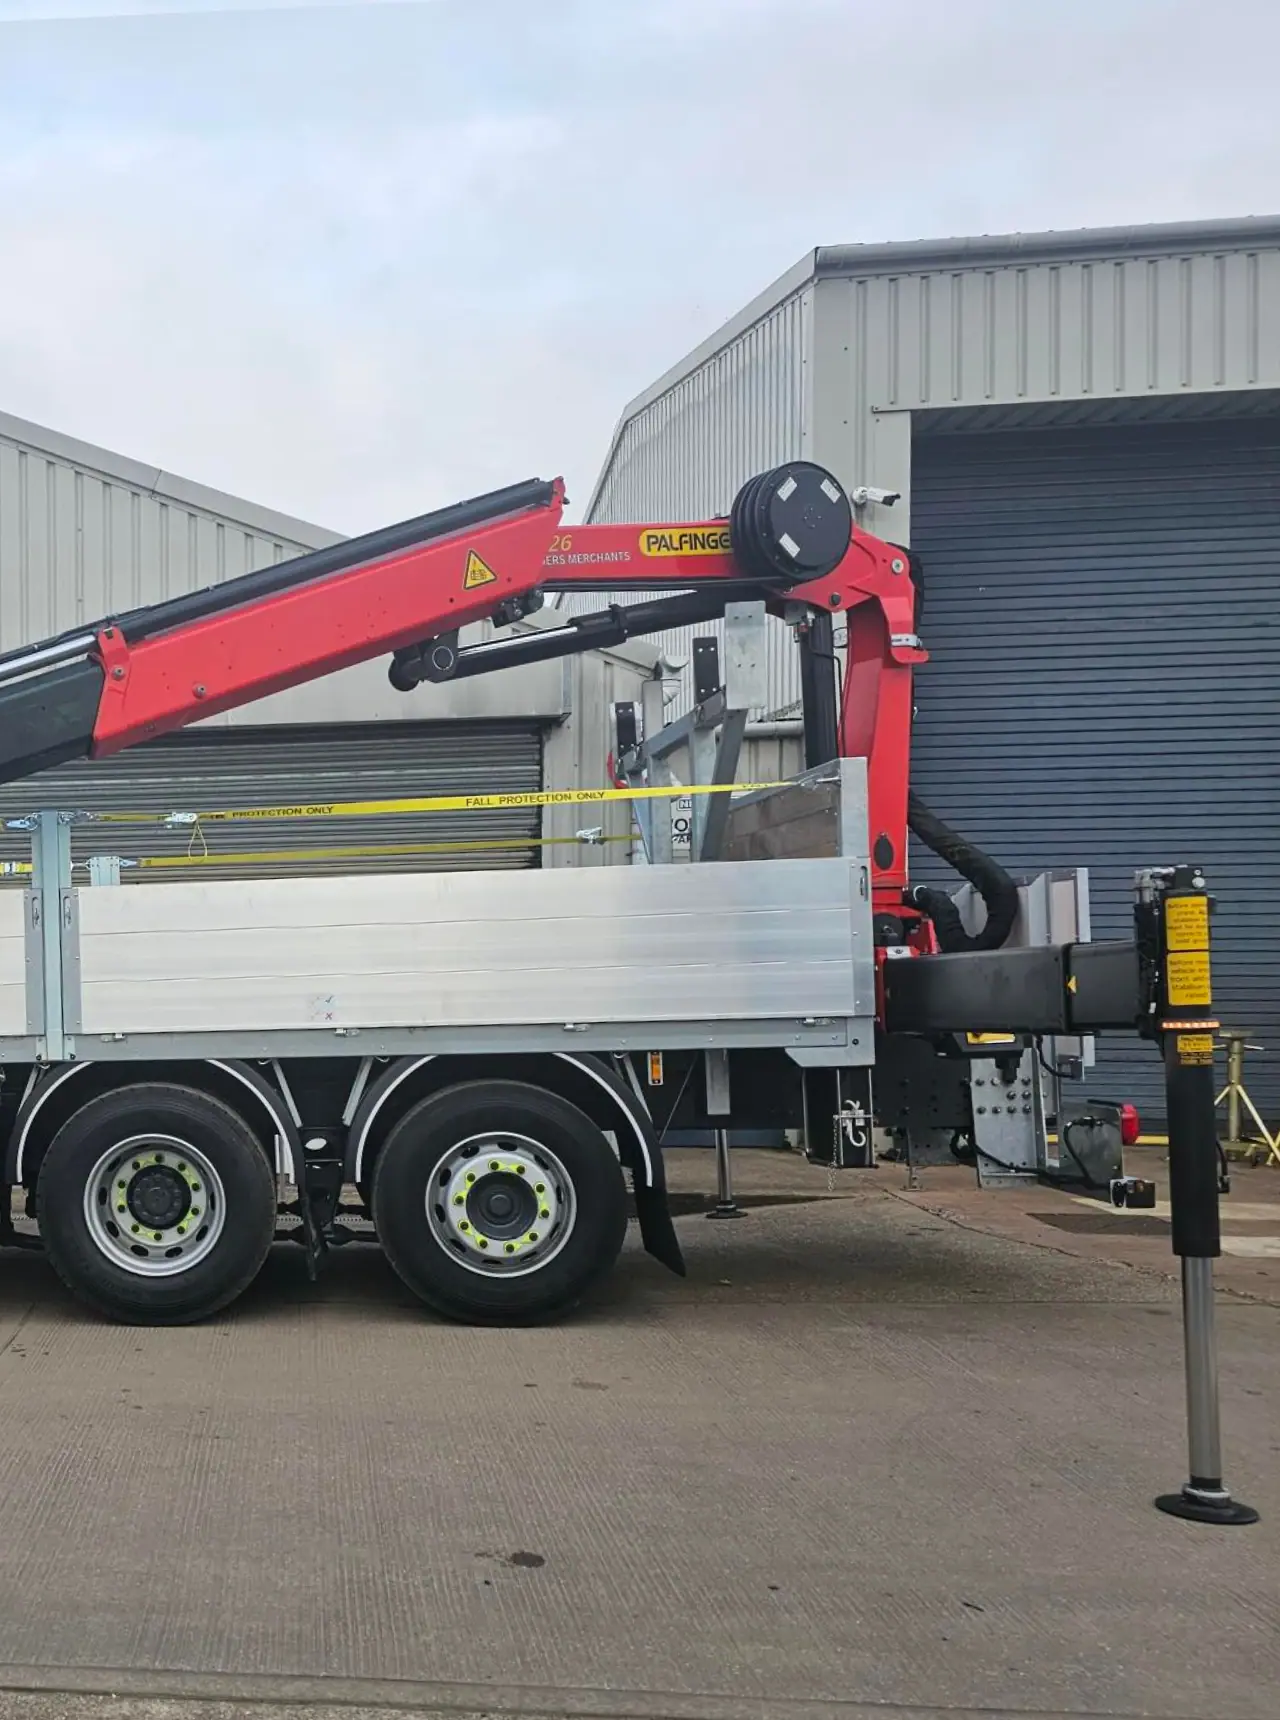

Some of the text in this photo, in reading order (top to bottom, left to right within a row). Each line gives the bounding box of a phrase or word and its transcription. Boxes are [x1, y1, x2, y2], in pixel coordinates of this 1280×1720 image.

[548, 534, 573, 552] 26
[568, 551, 631, 565] MERCHANTS
[465, 791, 605, 807] FALL PROTECTION ONLY
[232, 808, 302, 818] PROTECTION
[306, 806, 334, 815] ONLY
